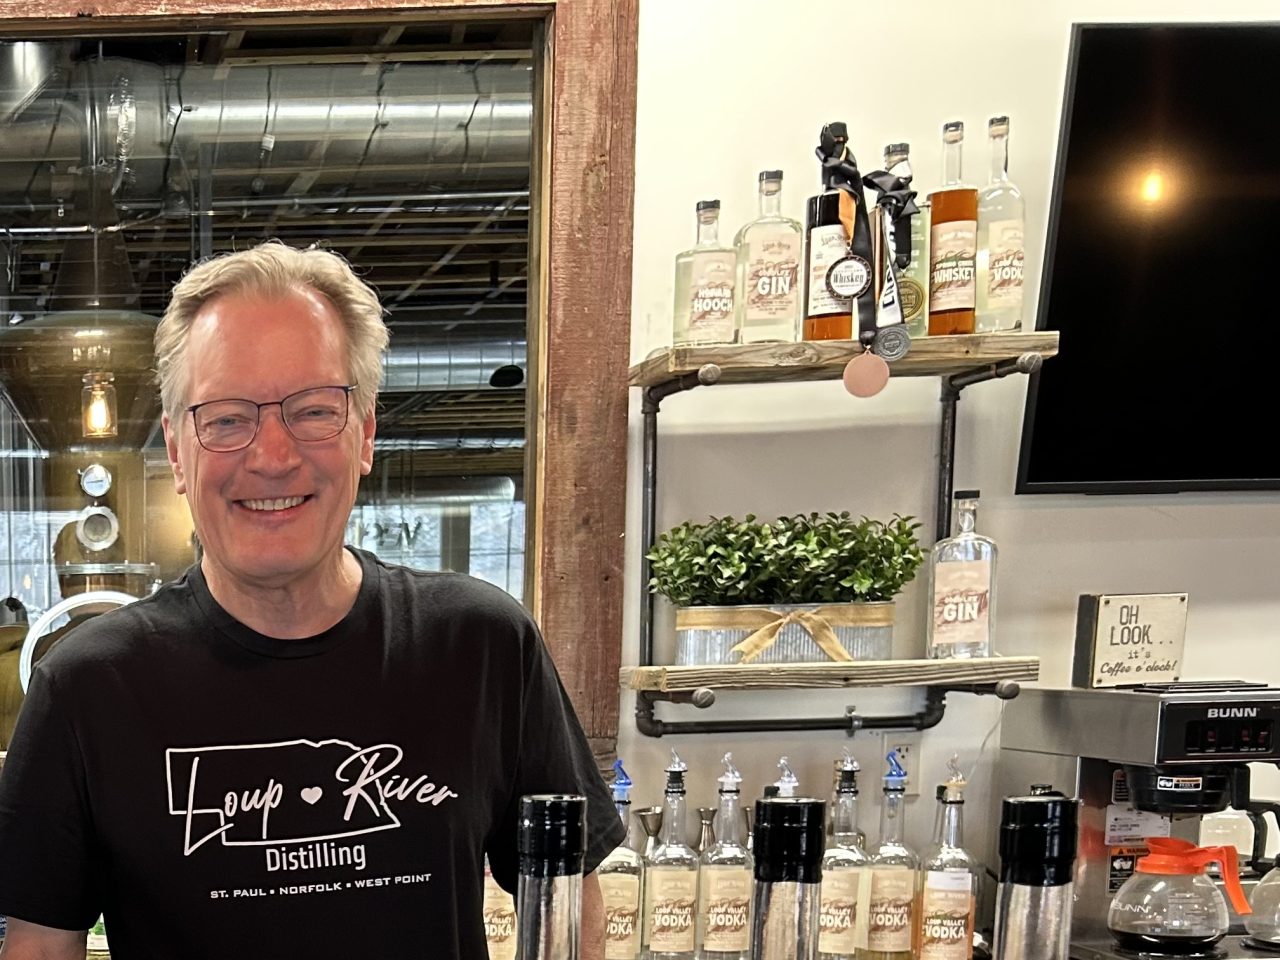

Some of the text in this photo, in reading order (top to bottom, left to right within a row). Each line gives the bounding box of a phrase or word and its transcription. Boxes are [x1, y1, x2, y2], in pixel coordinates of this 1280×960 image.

[834, 273, 864, 284] Whiskey
[934, 266, 974, 284] WHISKEY
[757, 276, 790, 295] GIN
[693, 299, 733, 312] HOOCH
[944, 602, 978, 621] GIN
[1120, 605, 1139, 625] OH
[1128, 647, 1150, 660] it's
[1100, 660, 1177, 676] Coffee o'clock!
[1207, 708, 1257, 718] BUNN
[184, 744, 458, 856] Loup River
[266, 842, 366, 872] Distilling
[210, 873, 432, 898] ST. PAUL NORFOLK WEST POINT
[654, 914, 692, 926] VODKA
[709, 914, 746, 926] VODKA
[870, 914, 908, 926] VODKA
[924, 925, 966, 938] VODKA
